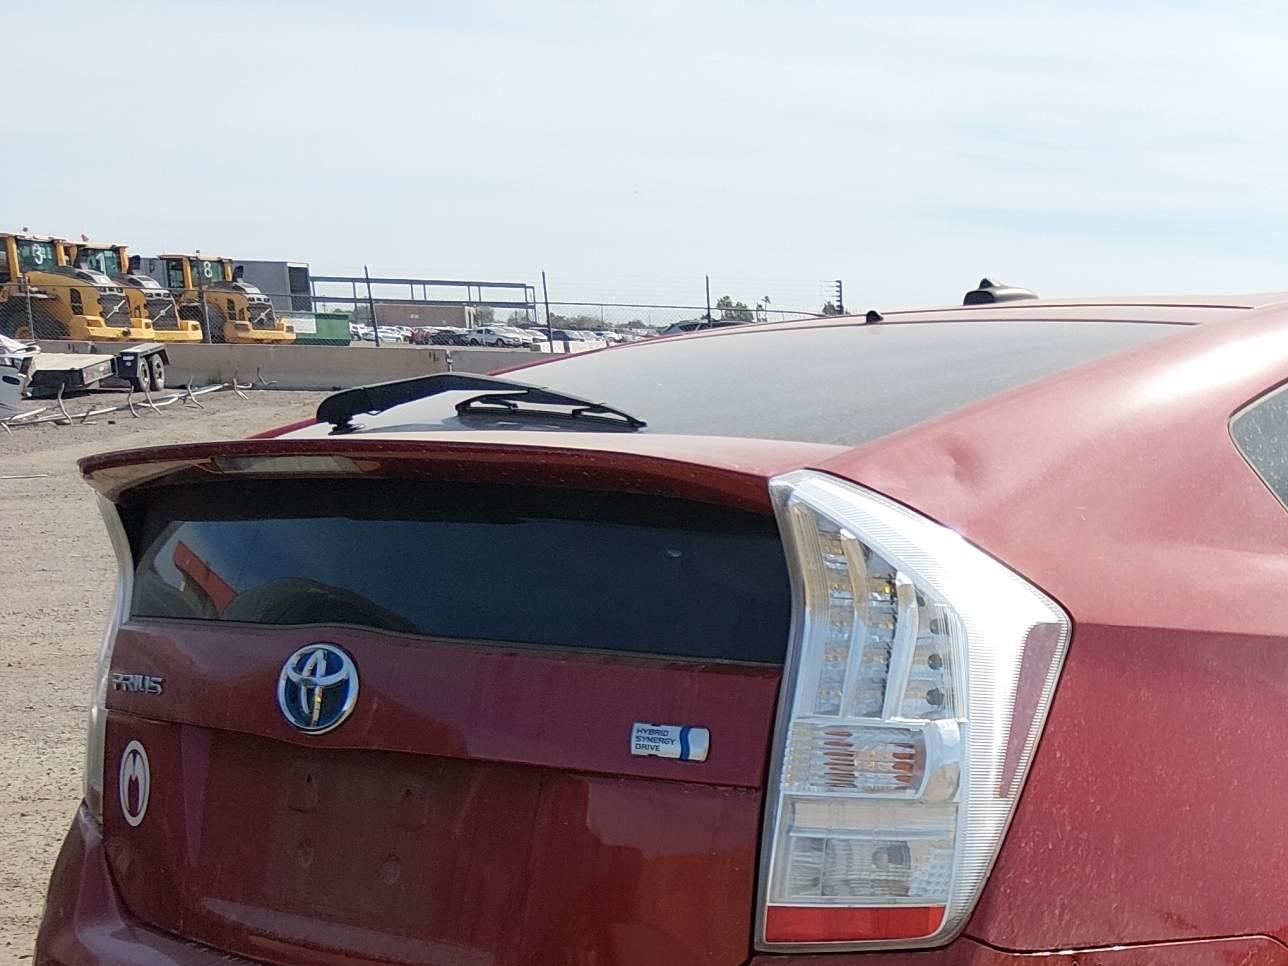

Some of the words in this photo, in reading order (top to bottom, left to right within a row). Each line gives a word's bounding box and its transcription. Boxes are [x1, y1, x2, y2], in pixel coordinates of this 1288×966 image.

[32, 243, 44, 265] 3
[203, 261, 213, 278] 8
[112, 672, 163, 694] PRIUS
[636, 728, 669, 737] HYBRID
[635, 735, 676, 745] SYNERGY
[635, 743, 660, 752] DRIVE
